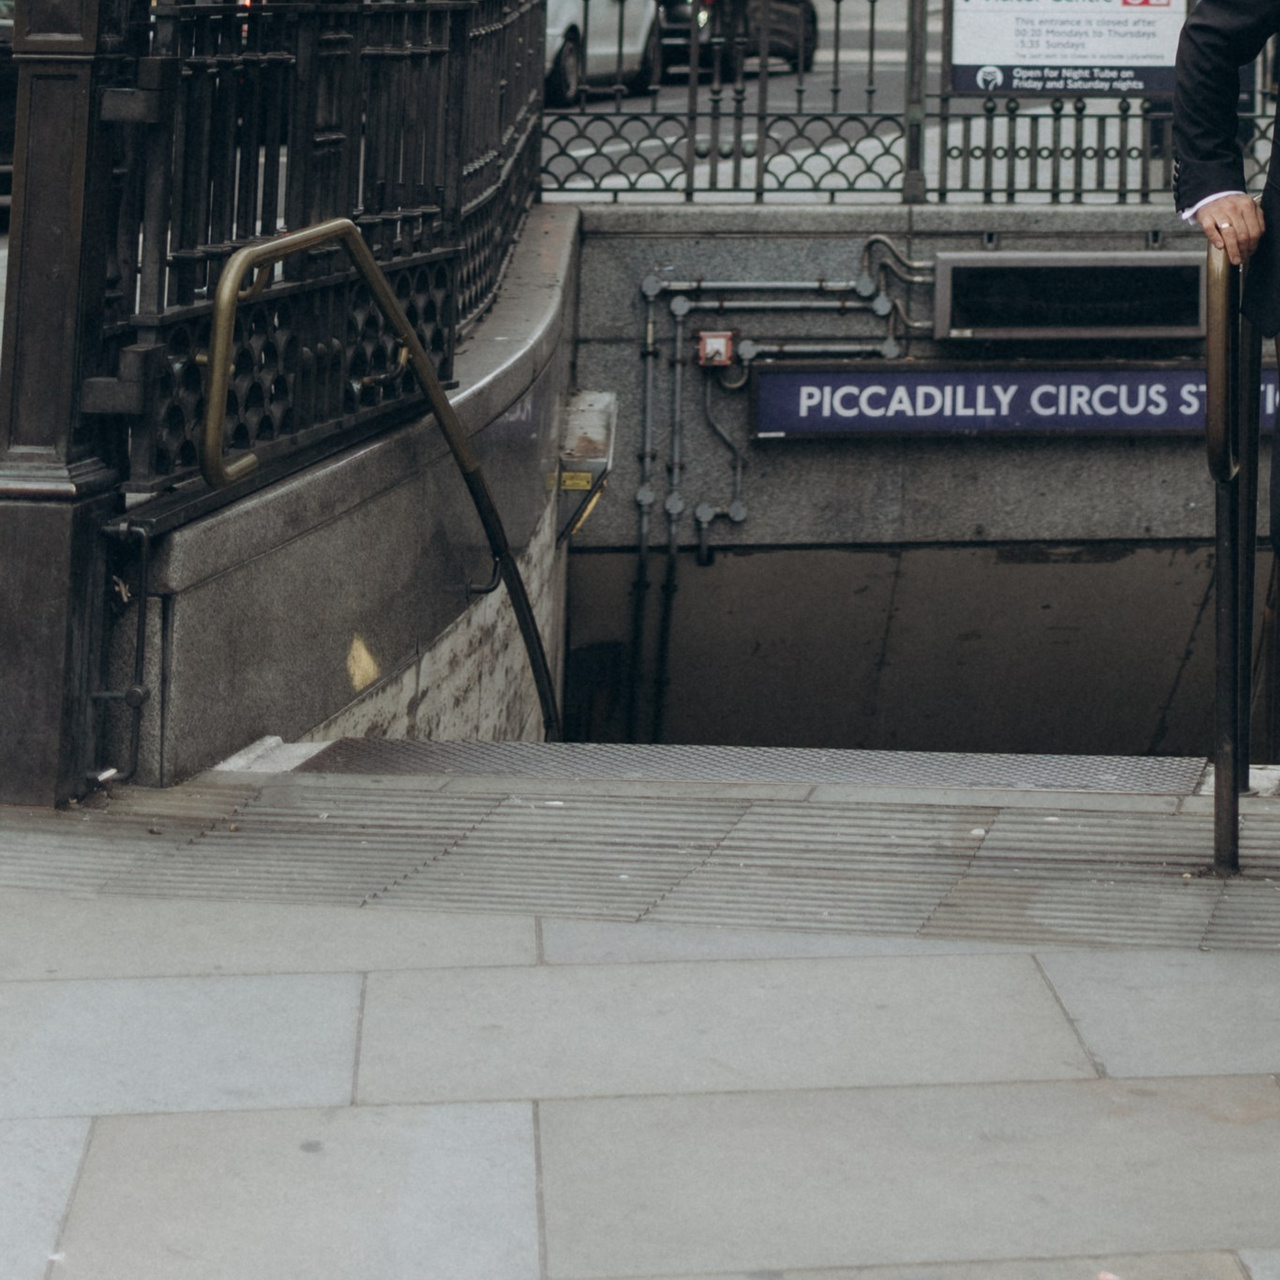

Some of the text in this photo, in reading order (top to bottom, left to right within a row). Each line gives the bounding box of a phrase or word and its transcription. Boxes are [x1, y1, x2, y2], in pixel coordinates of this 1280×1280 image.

[1015, 17, 1156, 27] This entrance is closed after
[1046, 28, 1089, 40] Mondays
[1092, 29, 1103, 39] to
[1107, 28, 1157, 41] Thursdays
[1013, 67, 1135, 80] Open for Night Tube on
[1012, 79, 1144, 91] Friday and Saturday nights
[799, 385, 1018, 417] PICCADILLY
[1030, 384, 1168, 416] CIRCUS
